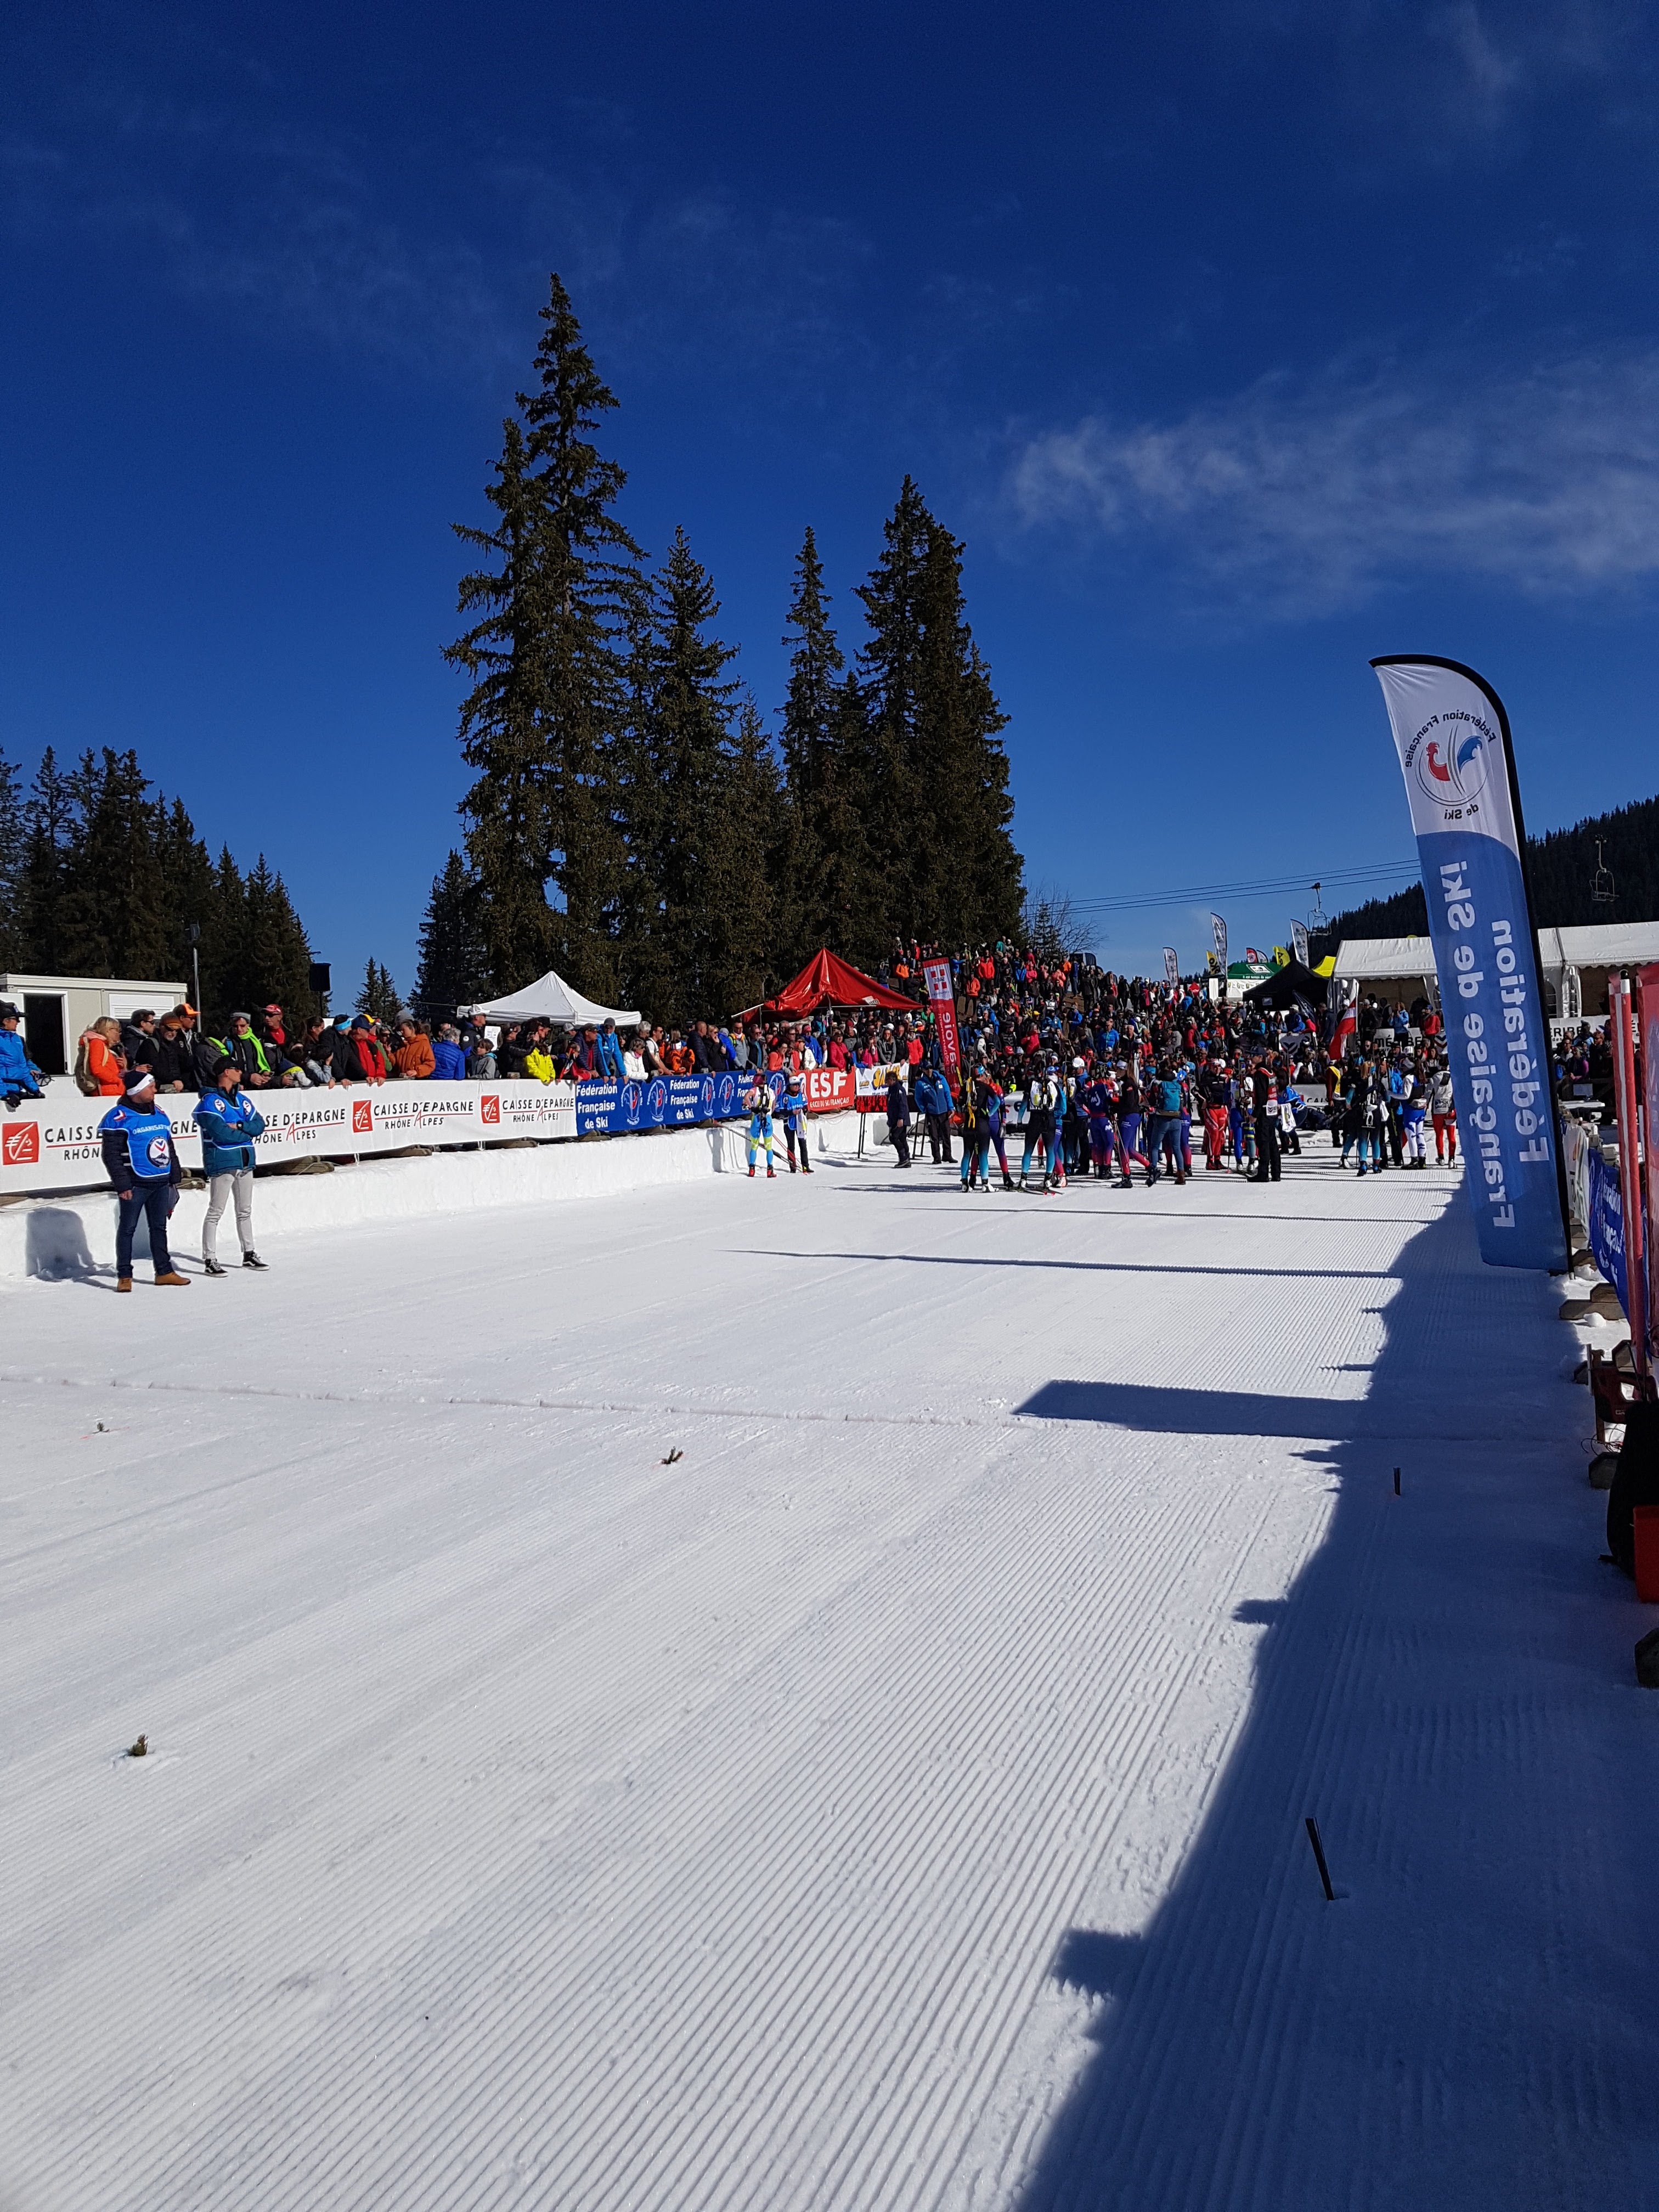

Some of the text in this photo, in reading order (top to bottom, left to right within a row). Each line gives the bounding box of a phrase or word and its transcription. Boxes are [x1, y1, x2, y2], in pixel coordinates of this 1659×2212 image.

[576, 1084, 618, 1097] Fédération
[810, 1071, 848, 1098] ESF
[503, 1099, 532, 1110] CAISSE
[578, 1099, 616, 1114] Française
[670, 1093, 698, 1107] Française
[283, 1108, 346, 1126] D'EPARGNE
[374, 1103, 408, 1116] CAISSE
[513, 1106, 558, 1124] RHÔNE ALPES
[676, 1109, 684, 1119] de
[684, 1108, 695, 1119] Ski
[385, 1109, 444, 1130] RHÔNE ALPES
[585, 1116, 608, 1129] de Ski
[251, 1122, 317, 1144] HÔNE ALPES
[64, 1146, 100, 1161] RHÔN
